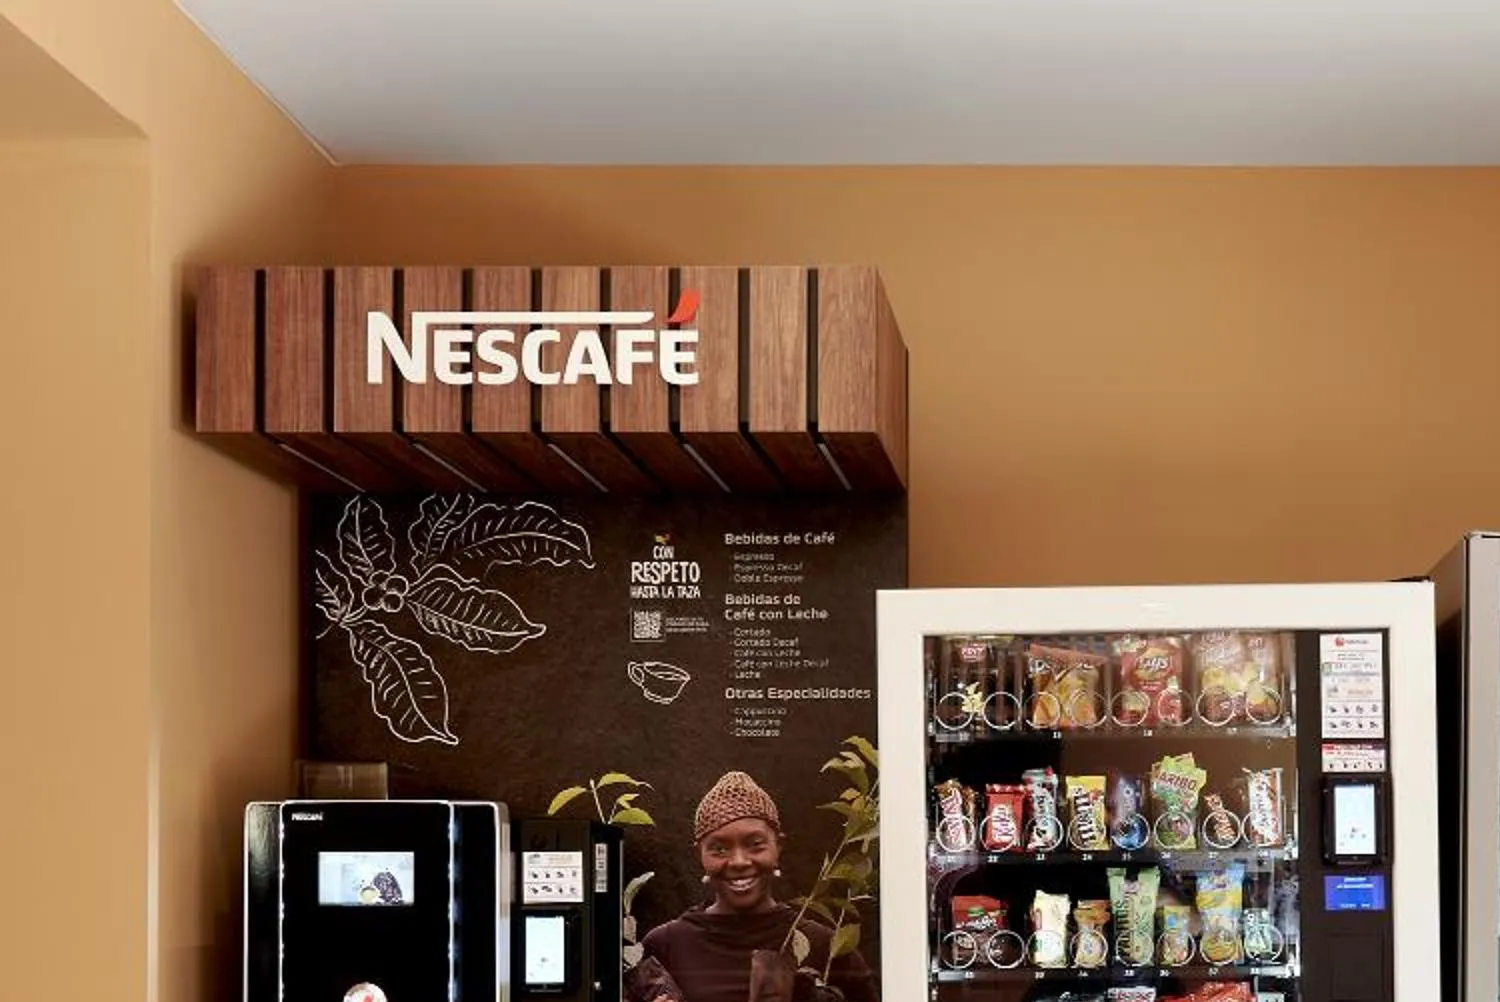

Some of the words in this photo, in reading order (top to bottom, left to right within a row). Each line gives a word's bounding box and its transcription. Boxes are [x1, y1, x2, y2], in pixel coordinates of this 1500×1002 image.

[366, 289, 700, 385] NESCAFÉ
[725, 532, 780, 545] Bebidas
[783, 532, 801, 545] de
[804, 531, 835, 545] Café
[653, 545, 675, 560] CON
[631, 561, 701, 584] RESPETO
[630, 585, 660, 599] HASTA
[661, 586, 675, 599] LA
[677, 585, 701, 599] TAZA
[725, 593, 780, 605] Bebidas
[783, 593, 801, 605] de
[725, 608, 755, 620] Café
[759, 611, 783, 620] con
[787, 608, 829, 620] Leche
[725, 687, 764, 699] Otras
[767, 687, 871, 701] Especialidades
